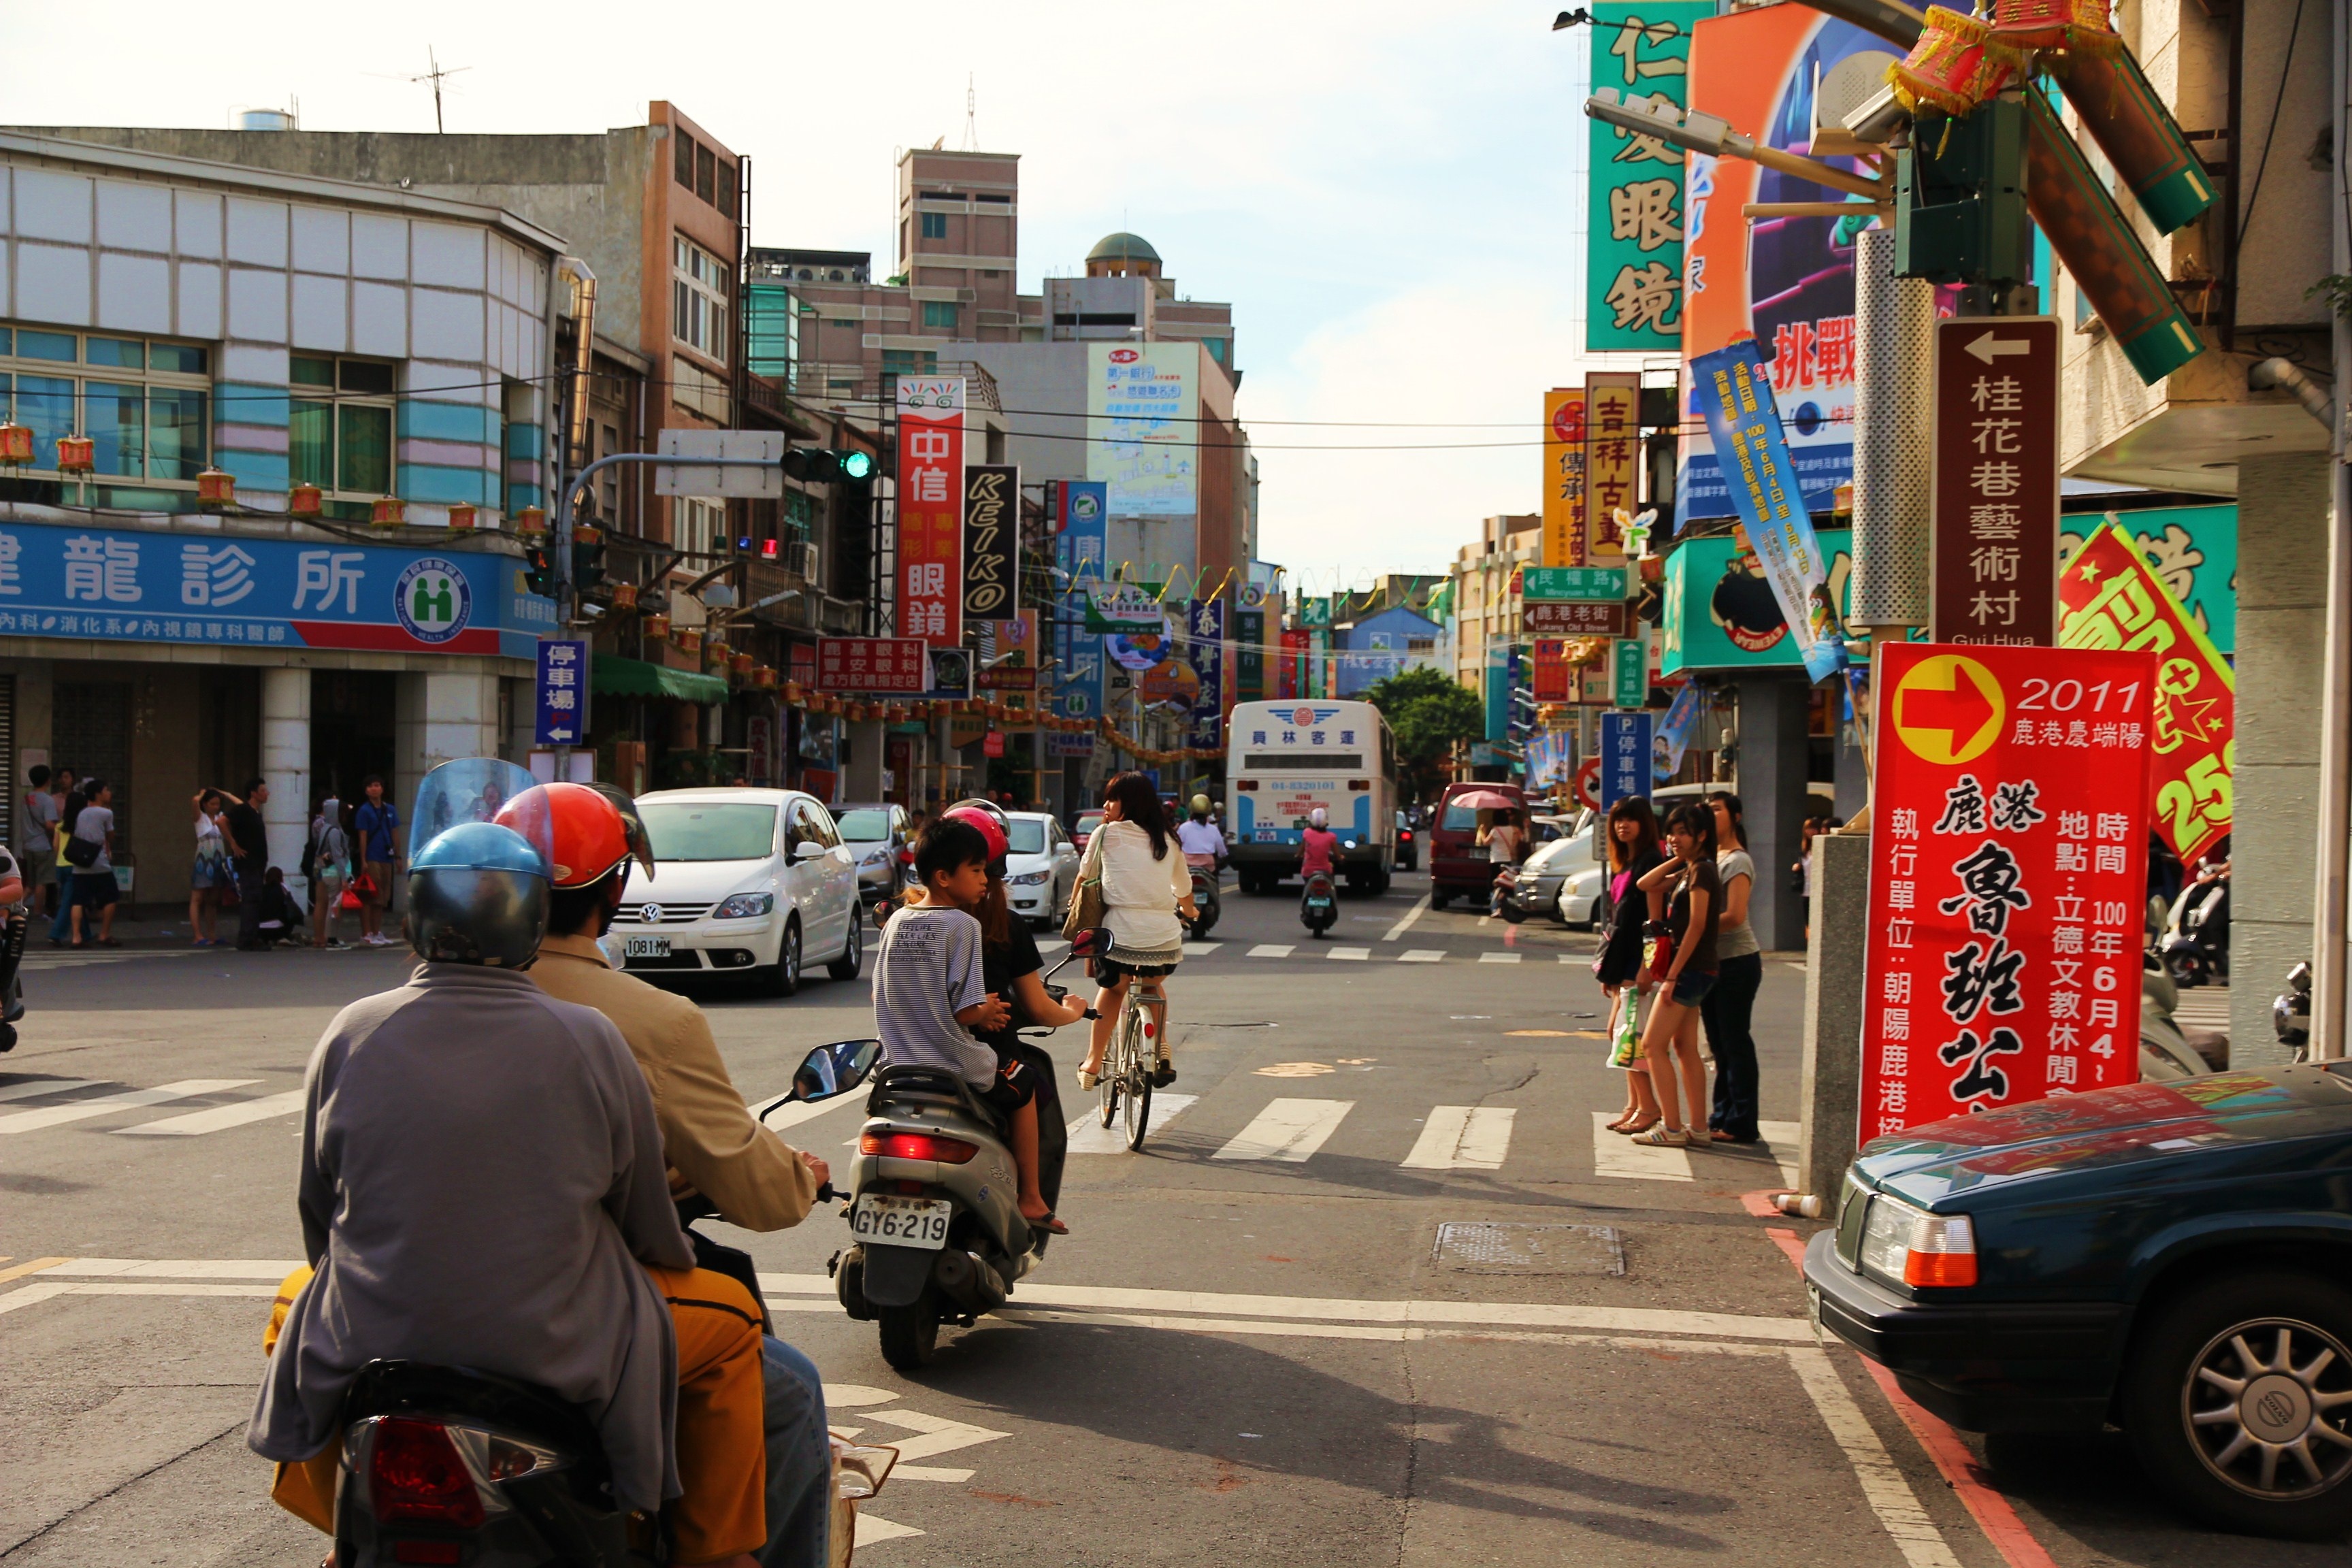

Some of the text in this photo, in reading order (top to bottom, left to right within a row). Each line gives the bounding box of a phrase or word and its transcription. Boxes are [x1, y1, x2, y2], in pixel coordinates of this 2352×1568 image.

[911, 429, 949, 502] 中信
[1595, 395, 1630, 549] 吉祥古董
[1970, 376, 2023, 626] 桂花巷藝術村
[965, 473, 1006, 612] KEIKO
[0, 534, 365, 614] 龍診所
[1538, 570, 1610, 586] 民權路
[908, 563, 945, 636] 眼鏡
[1536, 605, 1609, 621] 鹿港老街
[1535, 623, 1609, 634] Lukang Old Street
[1952, 634, 2035, 647] Gui Hua
[823, 642, 919, 657] 鹿基眼科
[546, 645, 576, 725] 停車場 P
[822, 674, 919, 687] 處方配鏡指定店
[1624, 653, 1636, 691] 中山路
[2016, 678, 2141, 713] 2011
[1252, 730, 1355, 745] 員林客運
[1622, 718, 1633, 732] P
[2010, 718, 2145, 749] 鹿港慶端陽
[1617, 736, 1637, 794] 停車場
[1933, 774, 2046, 836] 鹿港
[2094, 813, 2129, 875] 時間
[627, 940, 670, 953] 1081-MM
[1938, 840, 2032, 1119] 魯班公
[855, 1209, 947, 1241] GY6-219
[2264, 1394, 2289, 1424] VOLVO
